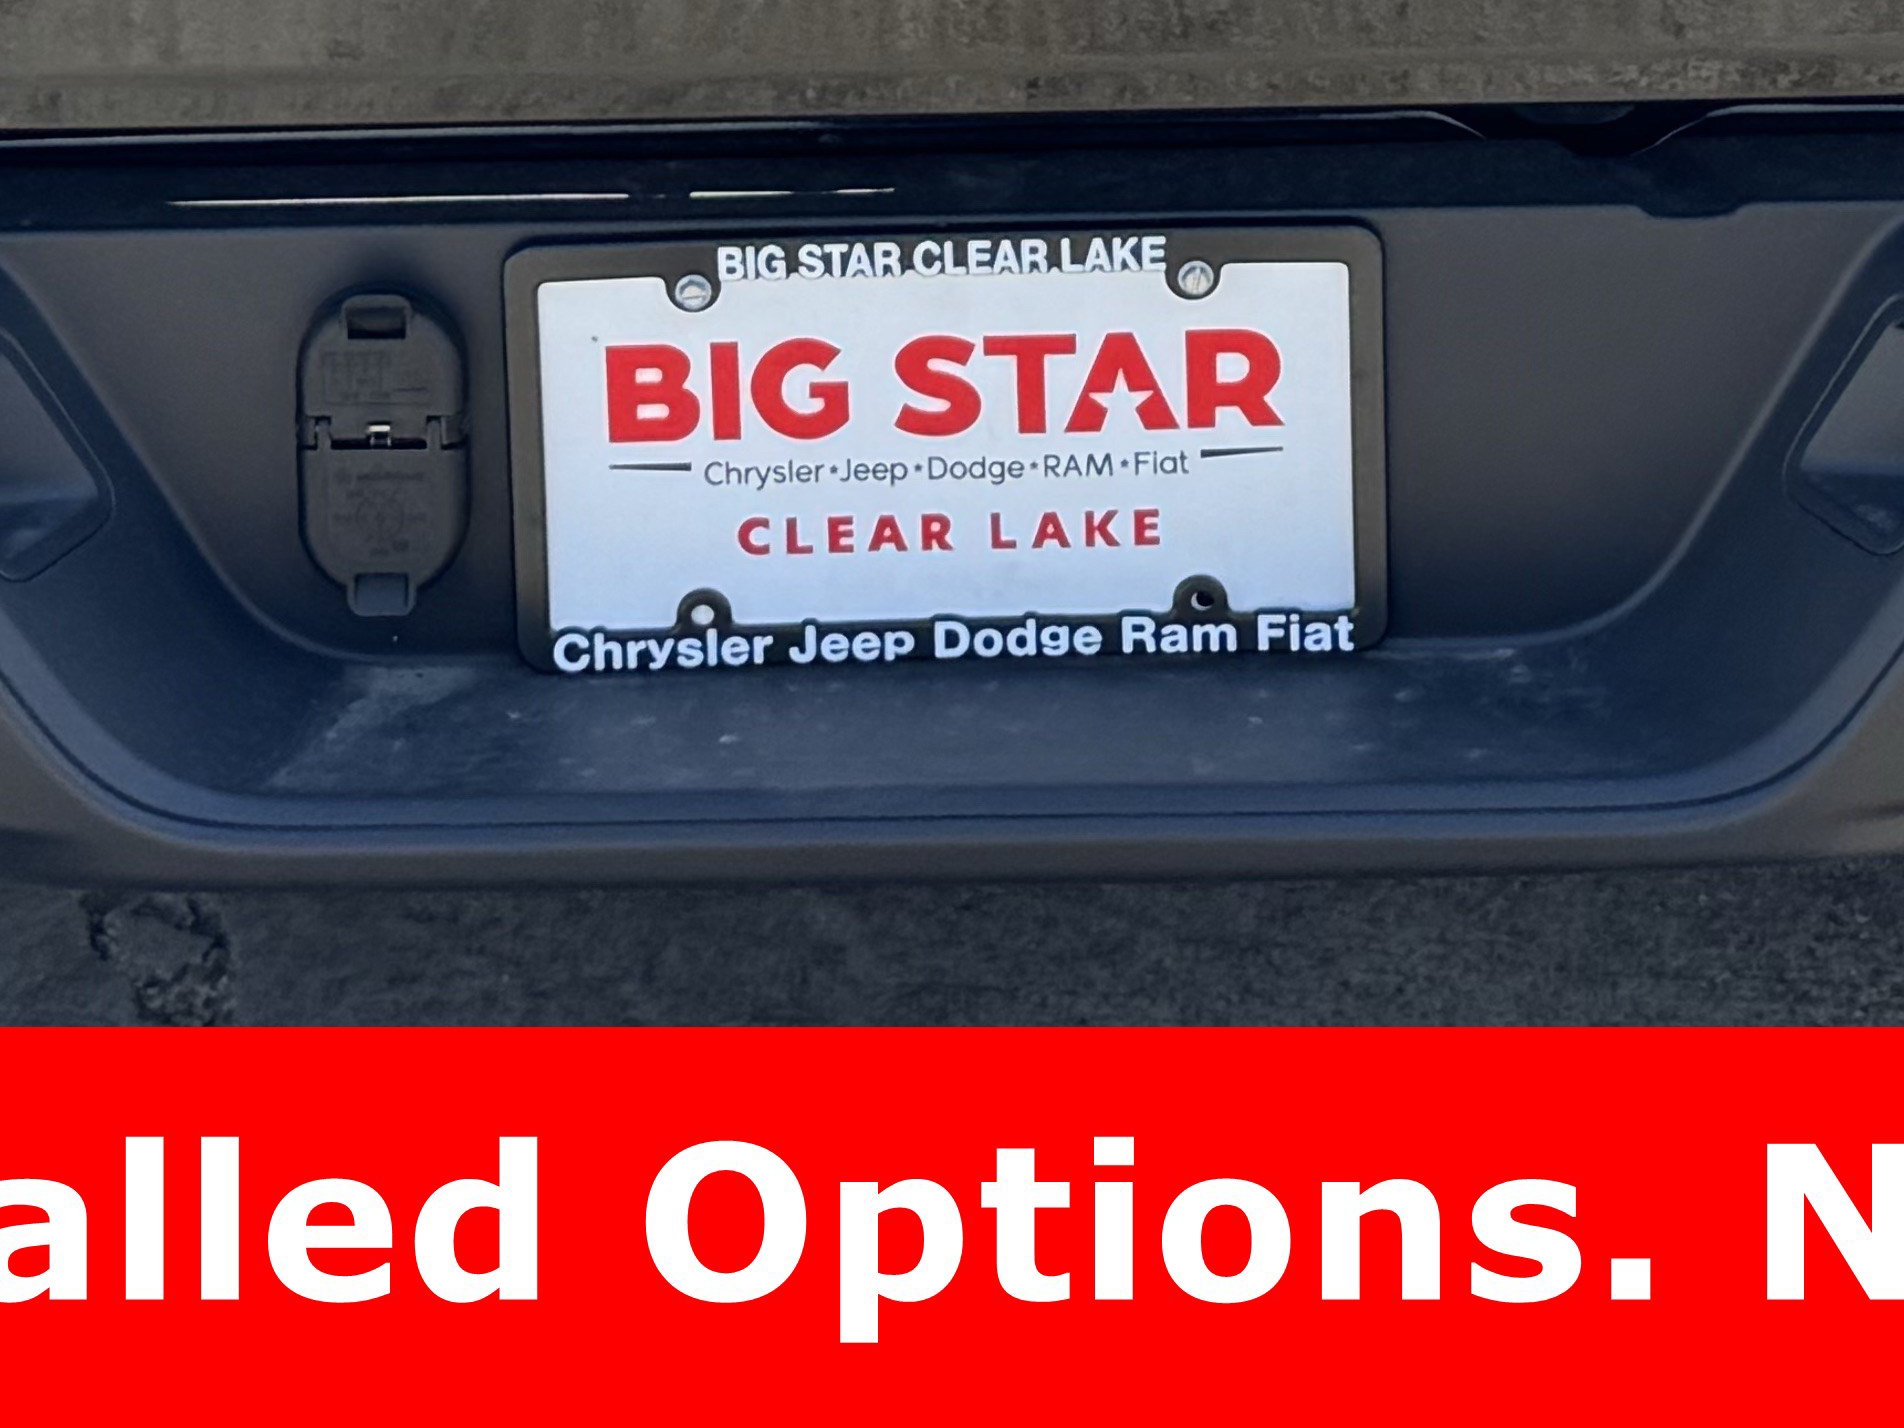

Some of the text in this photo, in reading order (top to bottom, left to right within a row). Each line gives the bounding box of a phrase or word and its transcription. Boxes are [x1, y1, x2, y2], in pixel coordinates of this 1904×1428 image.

[716, 235, 1168, 282] BIG STAR CLEAR LAKE
[604, 327, 1286, 444] BIG STAR
[736, 507, 1162, 557] CLEAR LAKE
[552, 613, 1356, 673] Chrysler Jeep Dodge Ram Fiat
